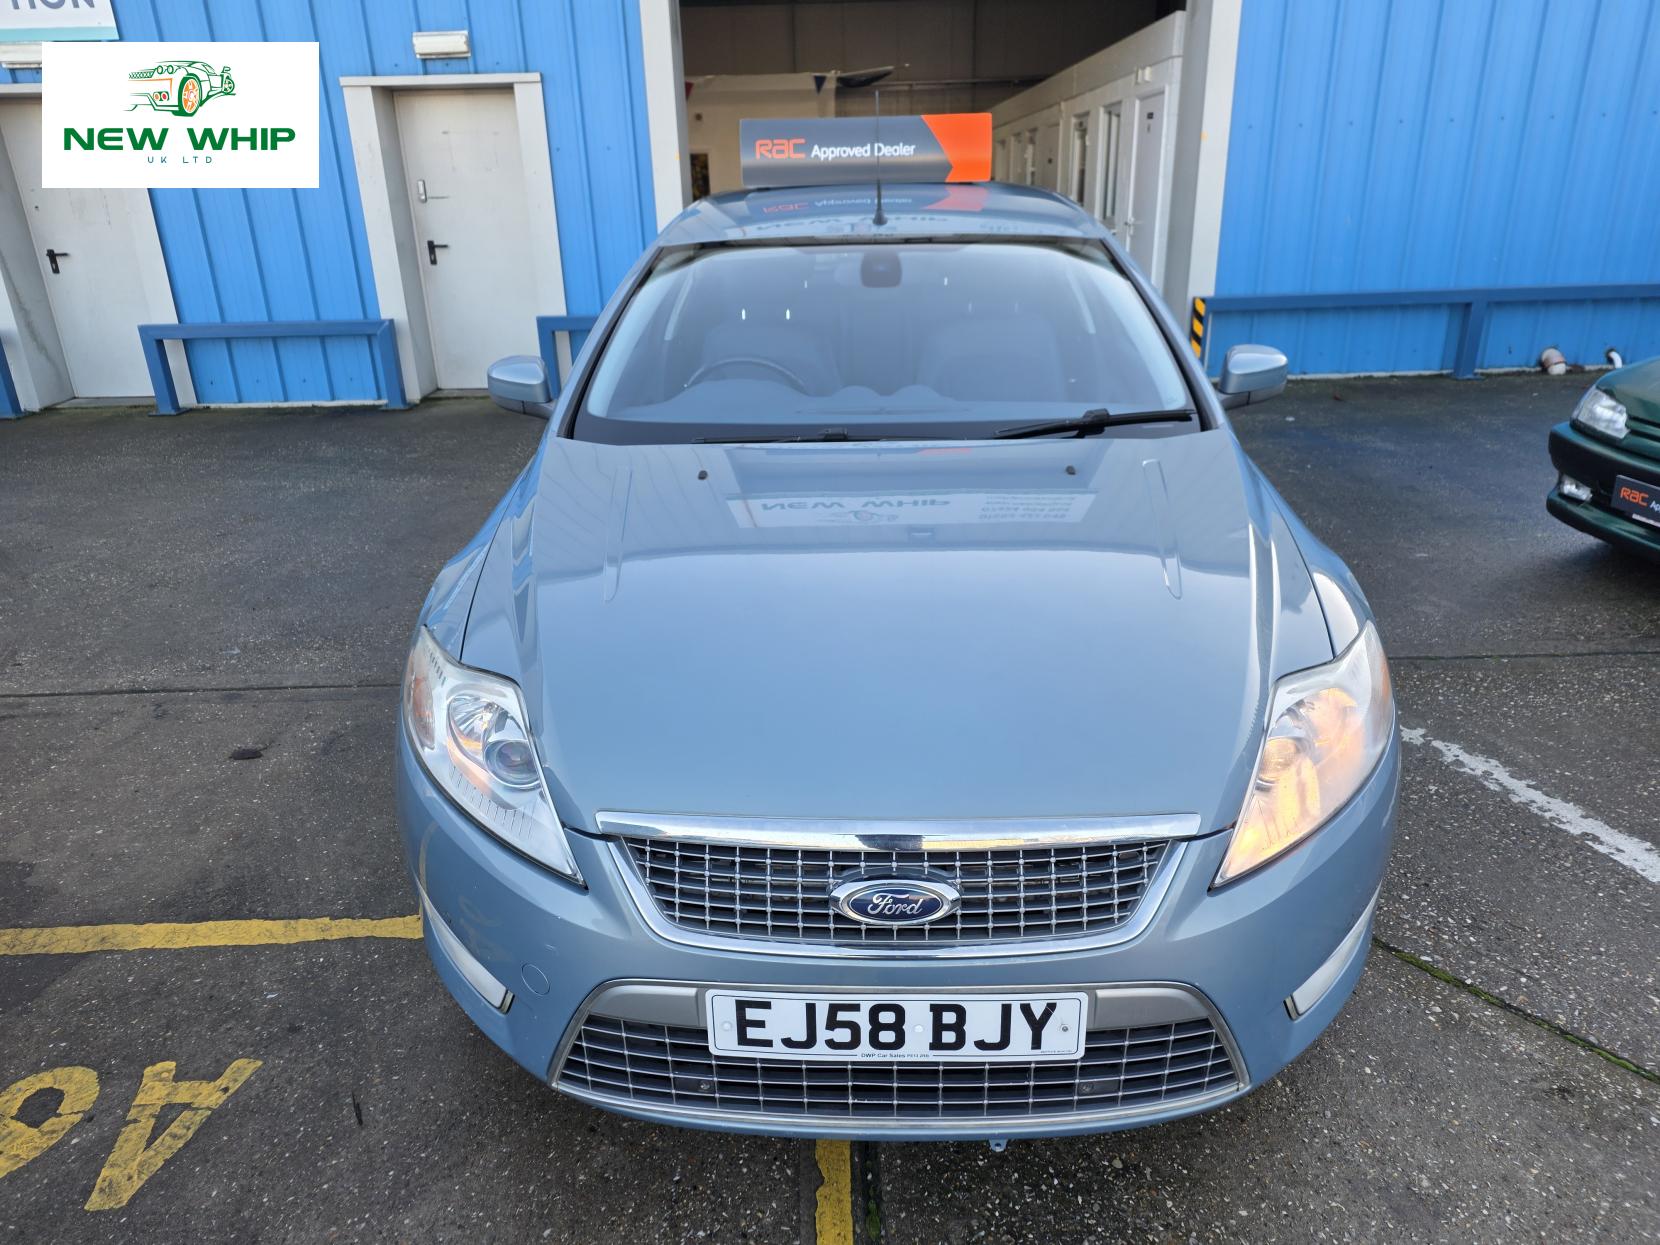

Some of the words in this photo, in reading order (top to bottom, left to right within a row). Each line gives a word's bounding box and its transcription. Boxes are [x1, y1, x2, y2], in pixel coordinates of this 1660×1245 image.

[811, 143, 871, 161] Approved
[874, 142, 916, 157] Dealer
[867, 892, 924, 915] Ford
[735, 999, 906, 1050] EJ58
[929, 1002, 1057, 1051] BJY
